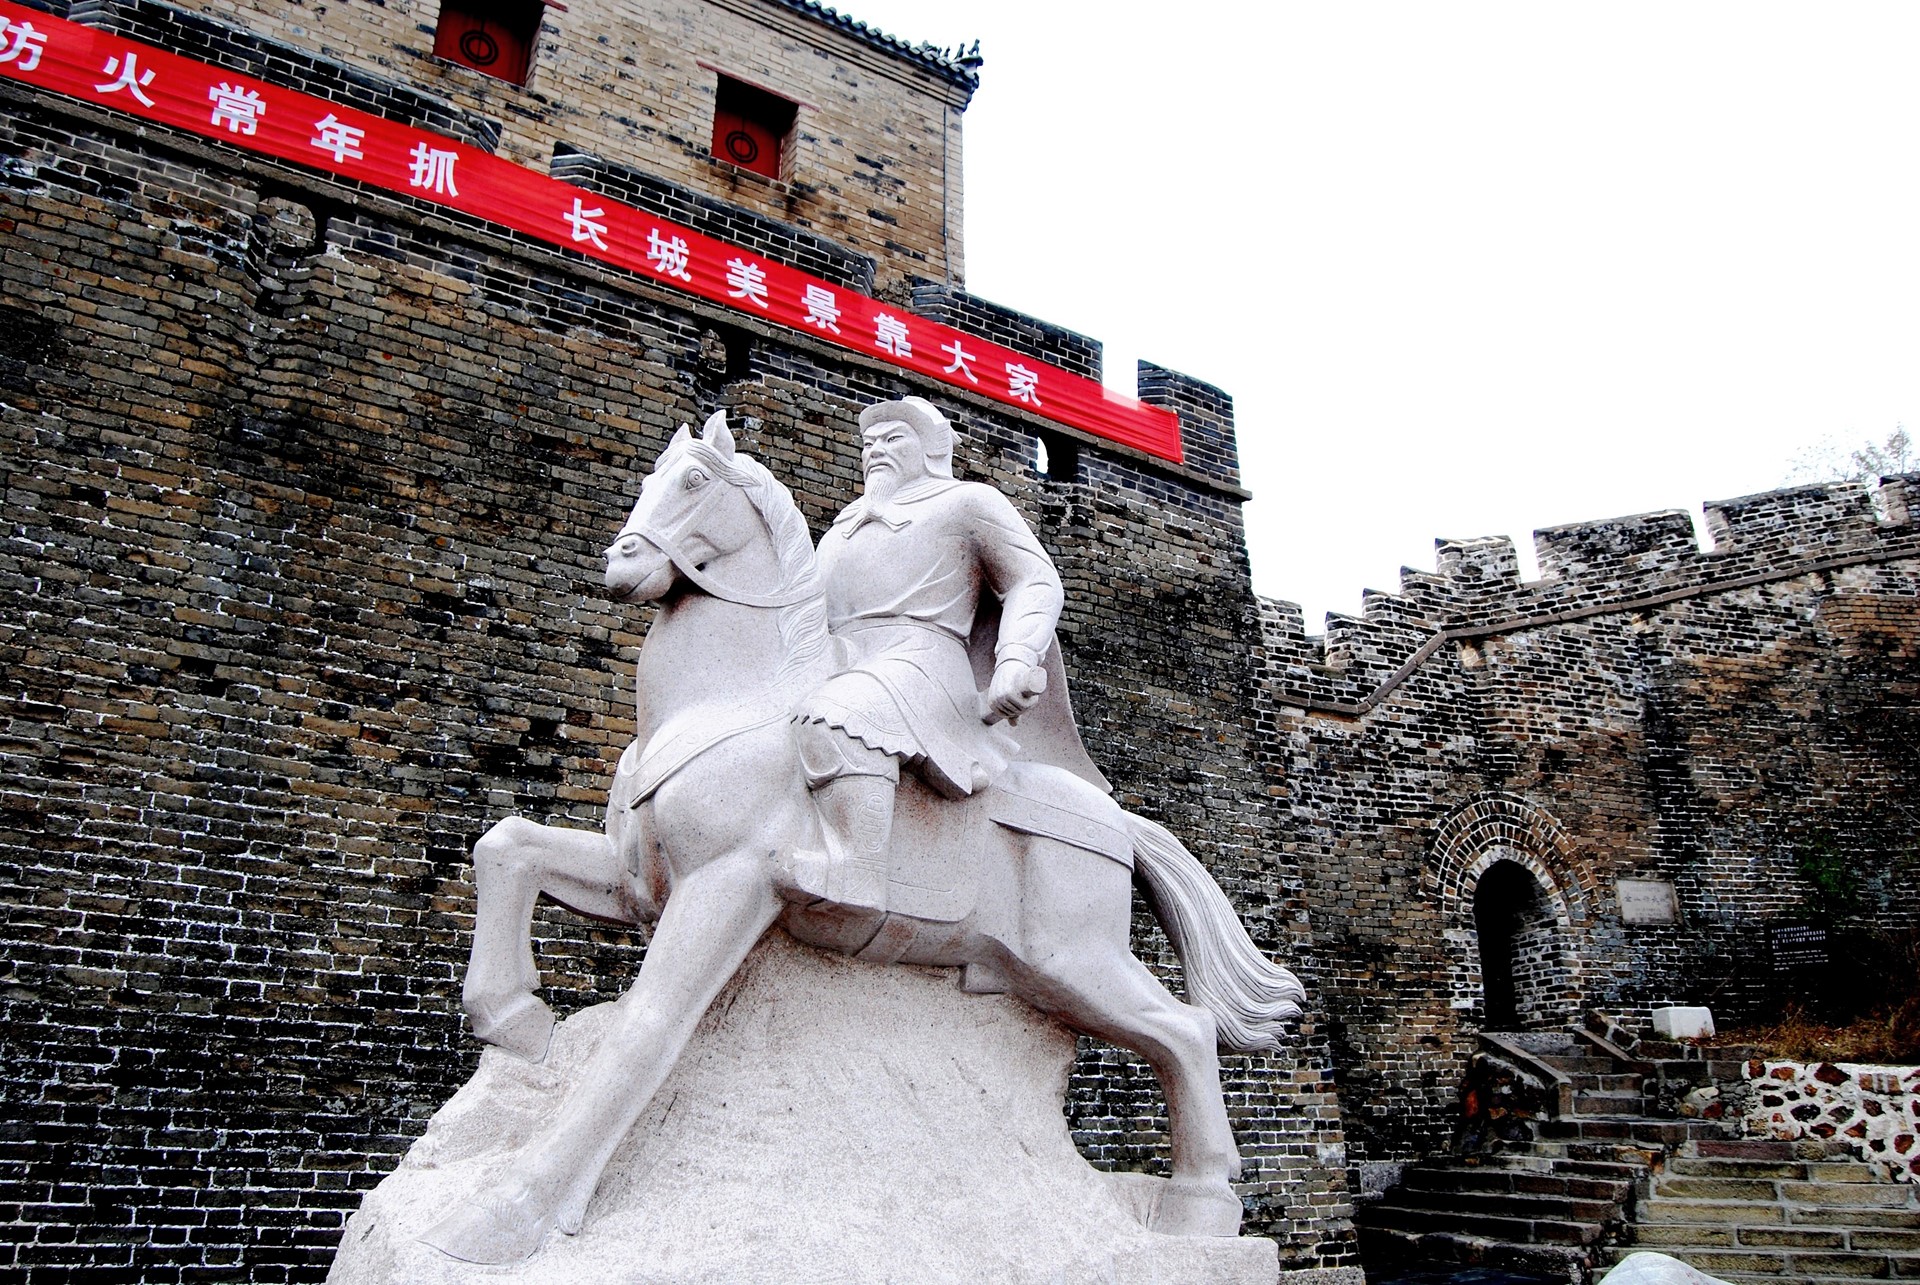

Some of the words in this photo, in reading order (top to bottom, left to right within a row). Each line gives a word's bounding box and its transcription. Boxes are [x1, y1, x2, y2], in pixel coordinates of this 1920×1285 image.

[0, 16, 458, 198] 防火常年抓
[564, 198, 1042, 407] 长城美景靠大家
